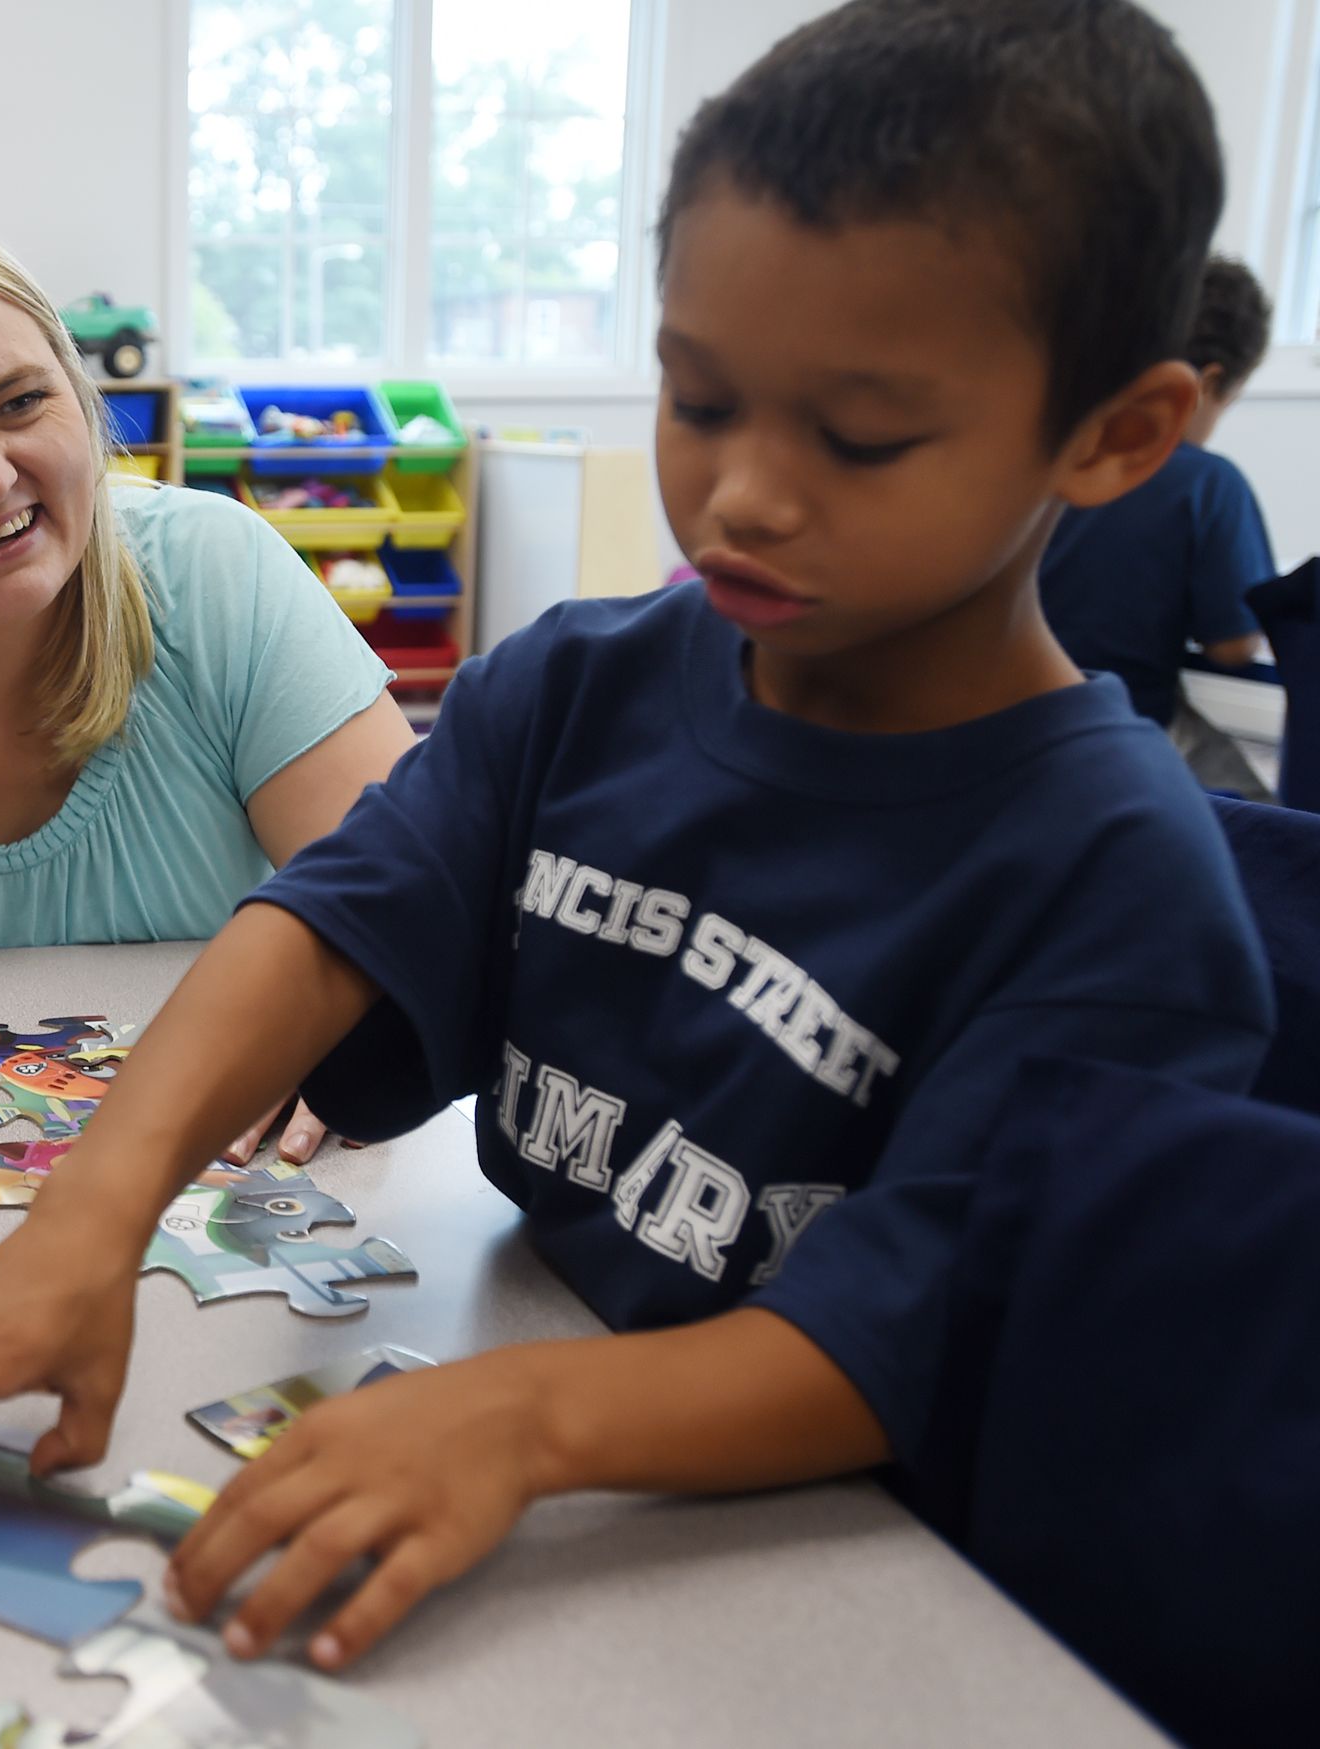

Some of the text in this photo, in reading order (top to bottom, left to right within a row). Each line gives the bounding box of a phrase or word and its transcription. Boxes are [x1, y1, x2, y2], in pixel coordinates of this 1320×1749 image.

[516, 848, 901, 1108] NCIS STREET
[494, 1040, 846, 1285] IMRY
